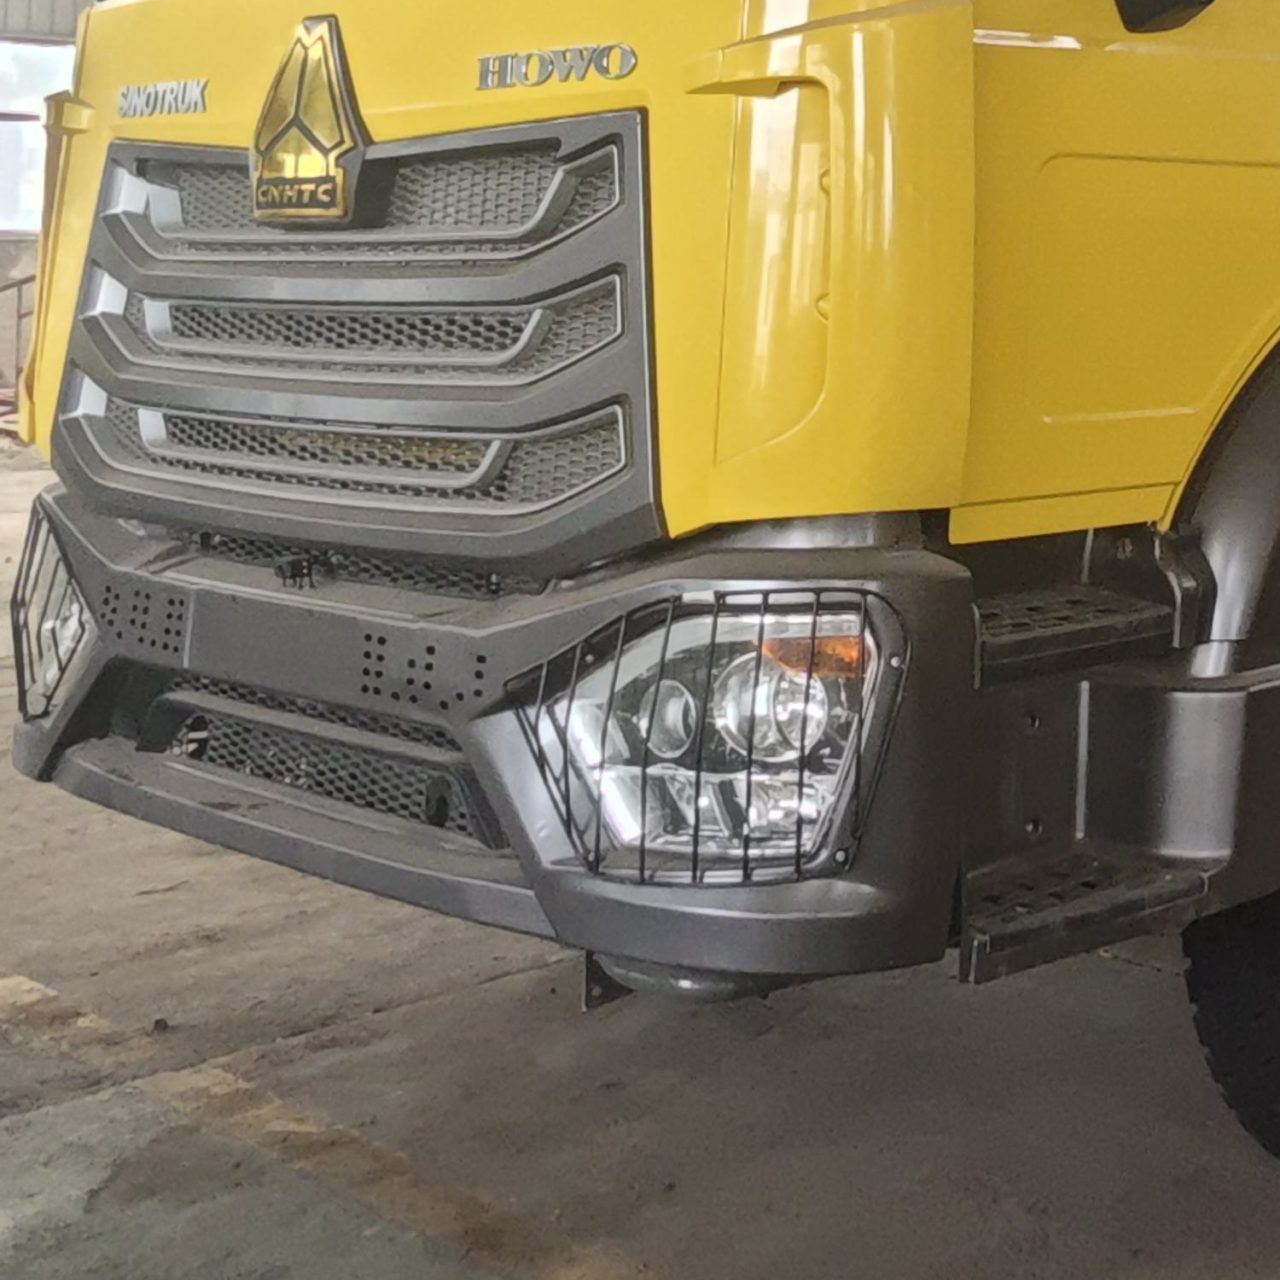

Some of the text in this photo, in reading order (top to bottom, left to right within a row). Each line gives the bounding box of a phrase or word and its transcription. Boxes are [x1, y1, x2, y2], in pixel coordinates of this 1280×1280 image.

[476, 43, 638, 91] HOWO
[119, 79, 208, 118] SINOTRUK
[258, 183, 334, 203] CNHTC
